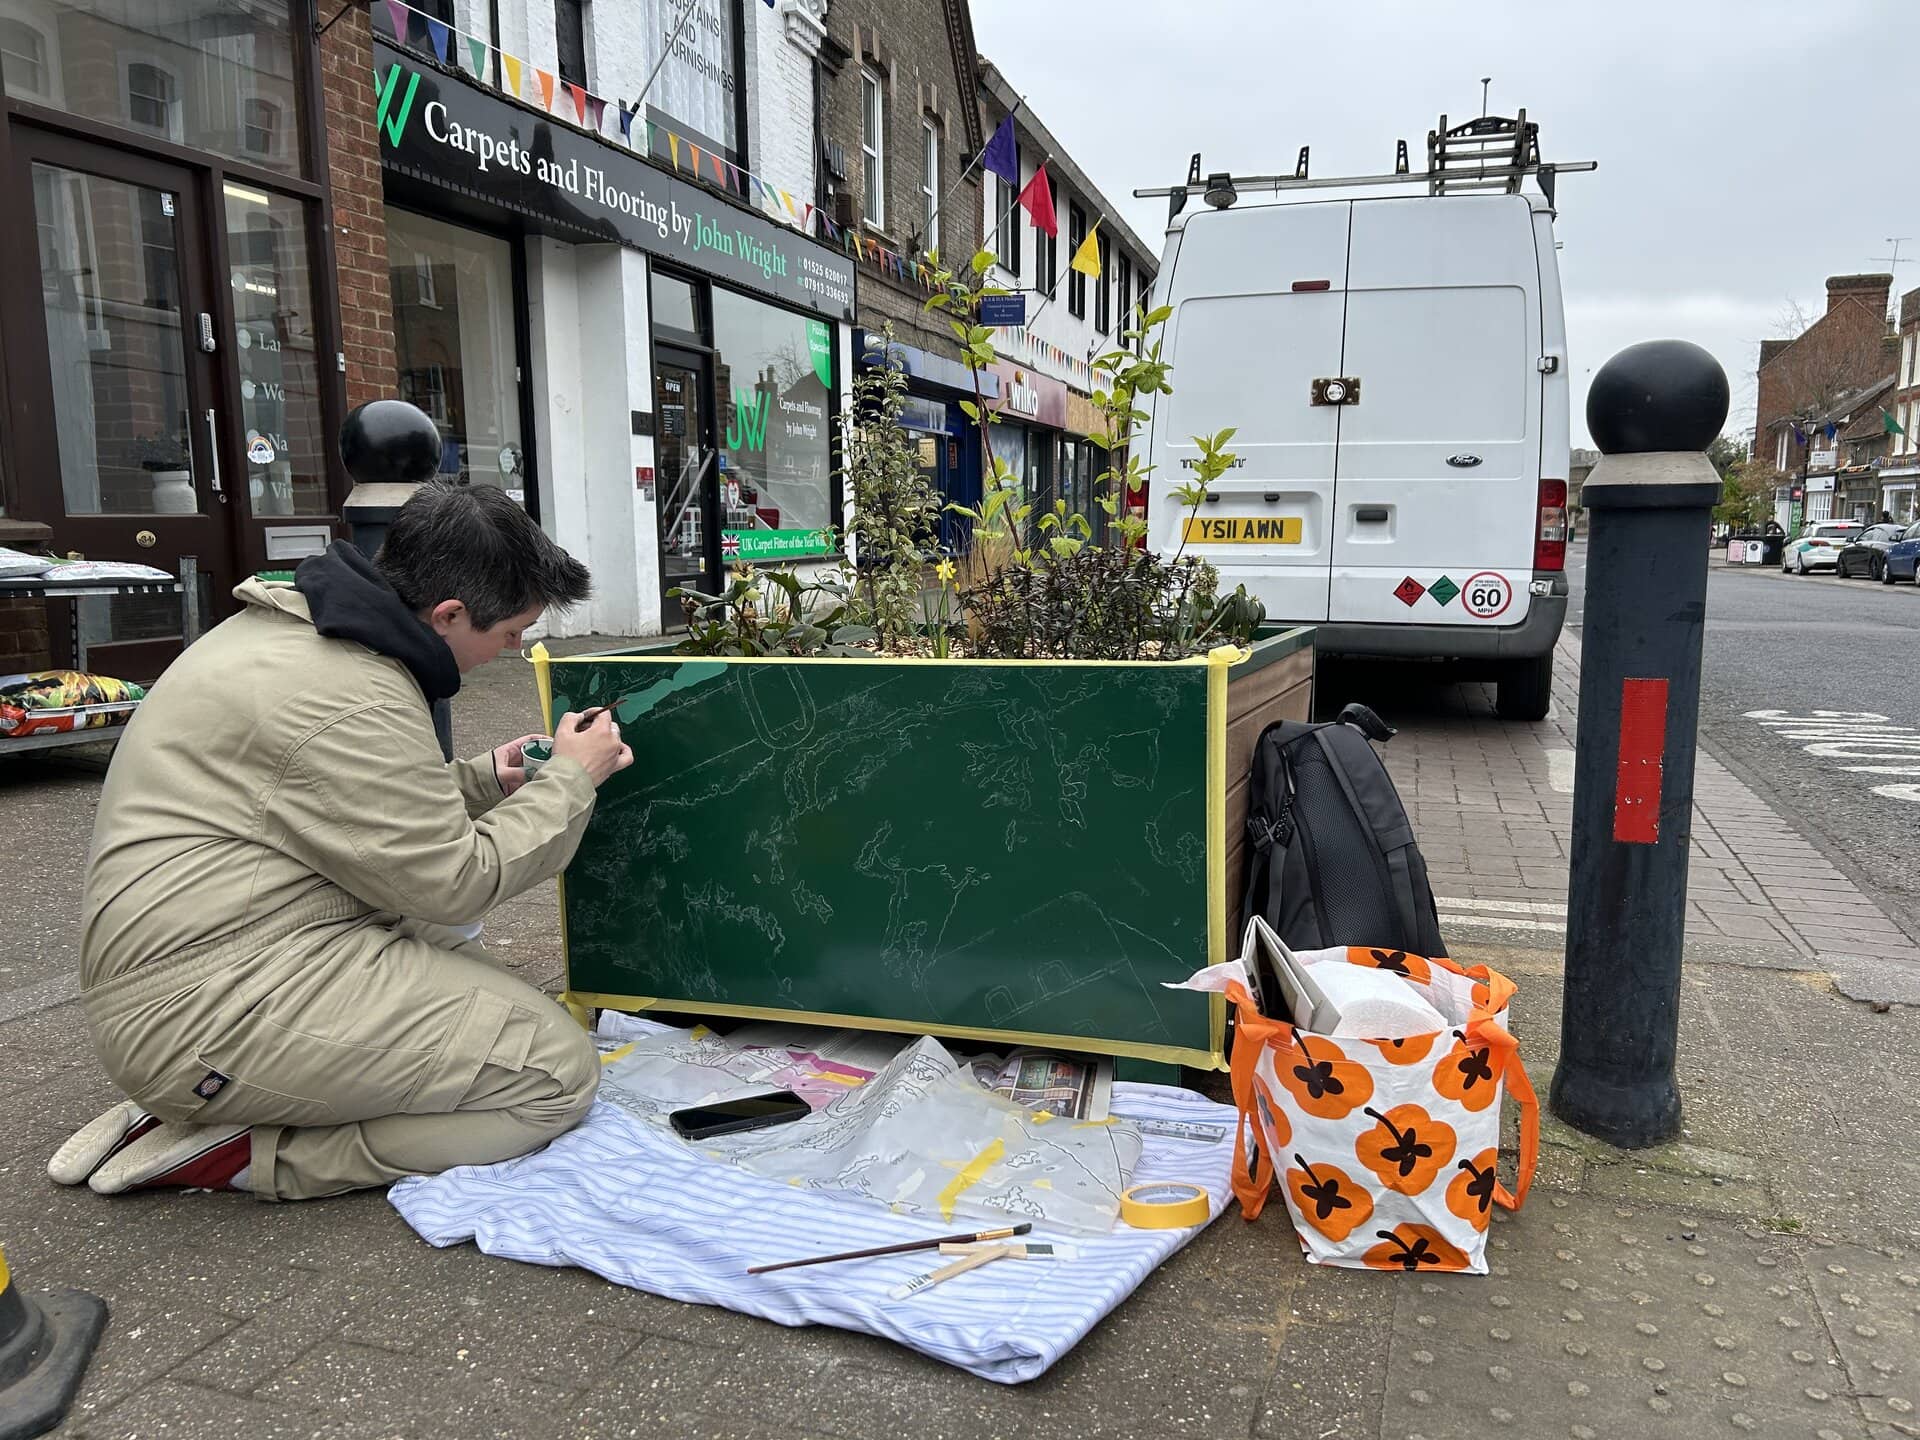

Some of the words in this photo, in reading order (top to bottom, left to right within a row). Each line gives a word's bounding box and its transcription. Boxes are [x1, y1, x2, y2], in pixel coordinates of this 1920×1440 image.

[674, 14, 696, 44] AND
[664, 31, 735, 93] FURNISHINGS
[424, 101, 531, 175] Carpets
[537, 158, 580, 194] and
[583, 165, 669, 239] Flooring
[671, 201, 692, 245] by
[694, 213, 734, 256] John
[735, 230, 788, 280] Wright
[803, 257, 823, 277] 01525
[804, 276, 824, 295] 07913
[665, 381, 681, 393] OPEN
[1011, 371, 1038, 416] wilko
[1201, 520, 1237, 538] YS11
[1243, 520, 1284, 538] AWN
[742, 538, 753, 551] UK
[753, 536, 773, 554] Carpet
[773, 536, 788, 549] Fitter
[1471, 588, 1501, 607] 60
